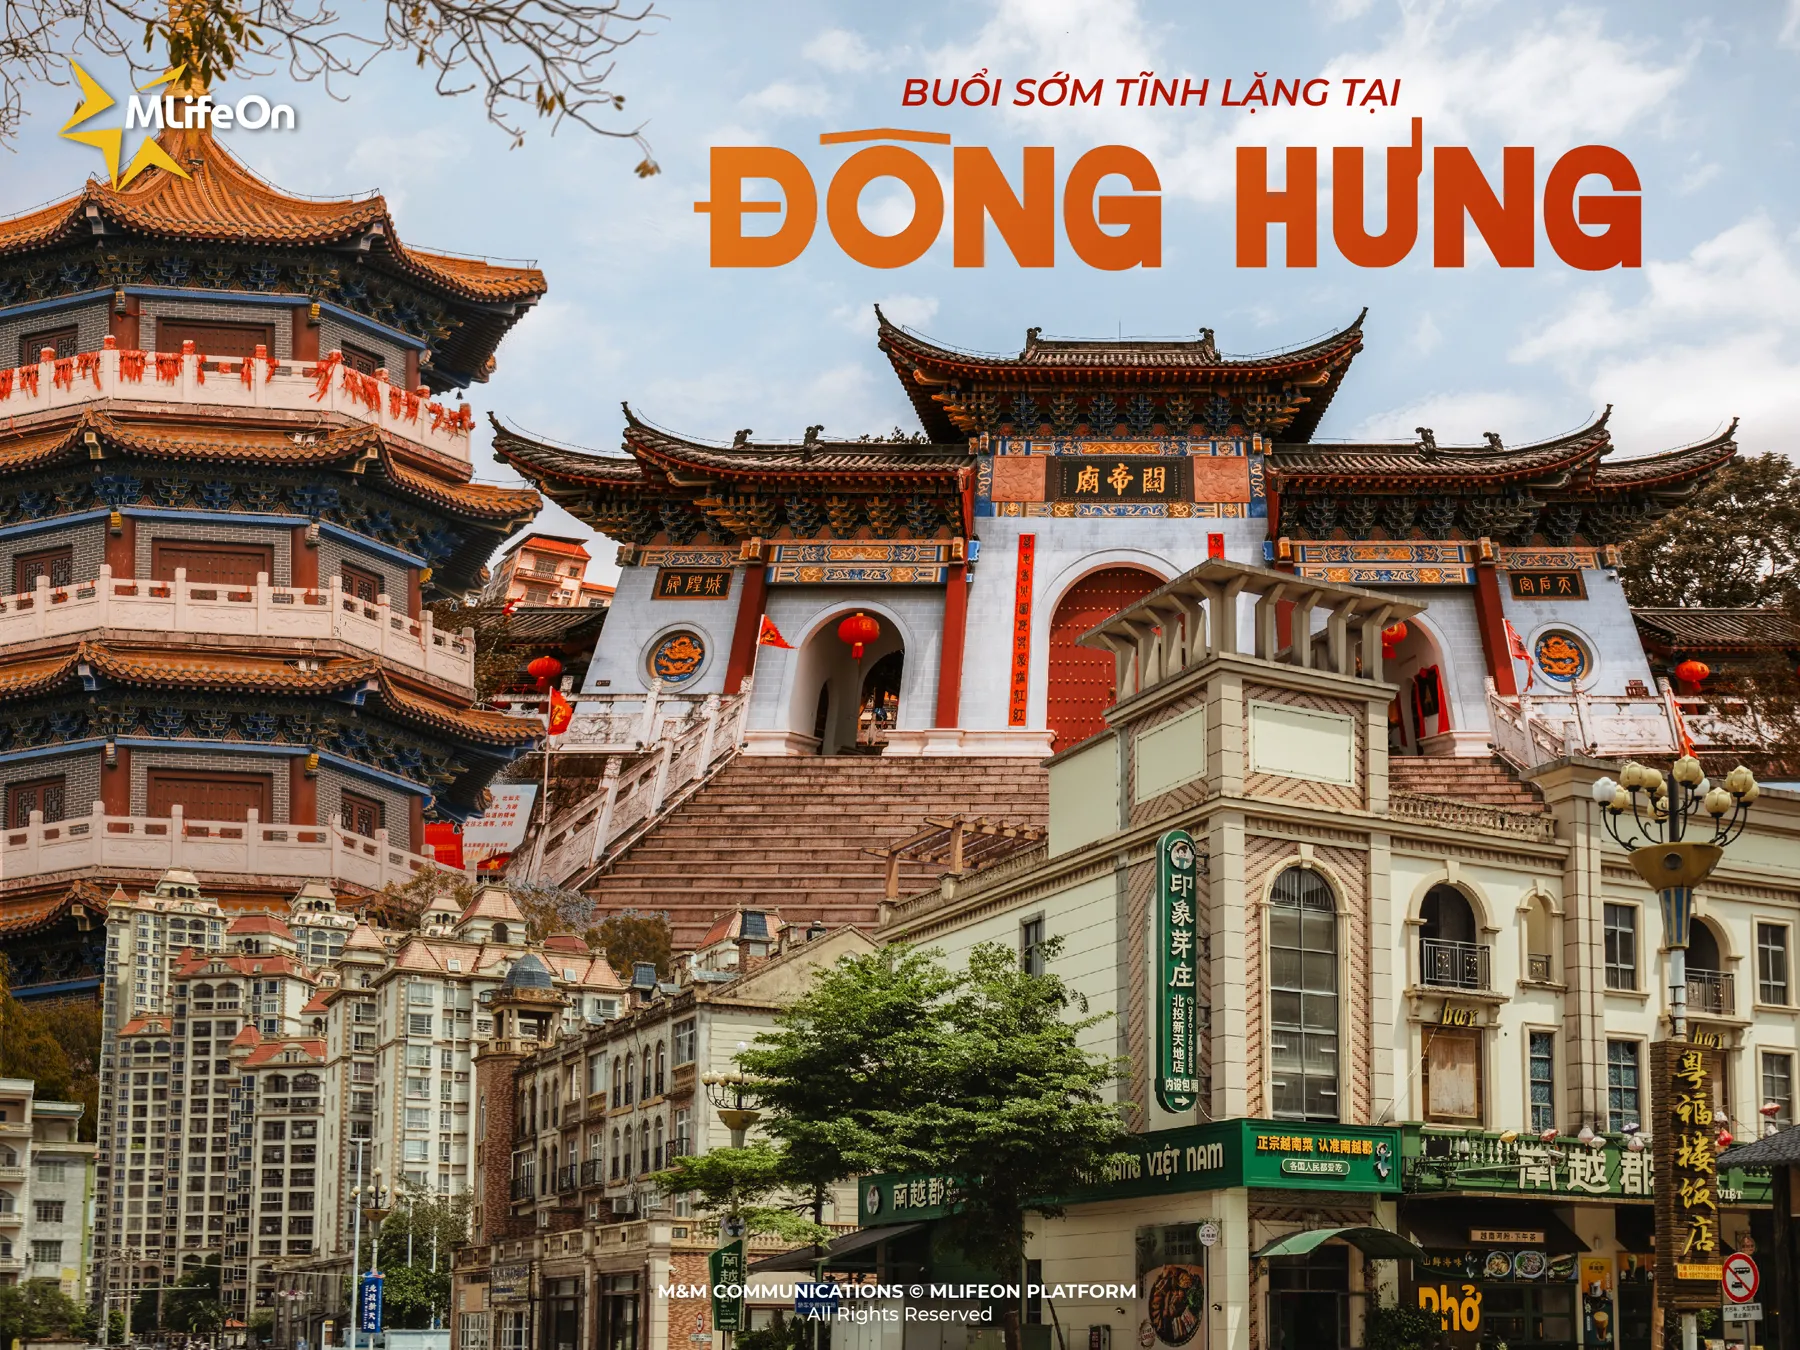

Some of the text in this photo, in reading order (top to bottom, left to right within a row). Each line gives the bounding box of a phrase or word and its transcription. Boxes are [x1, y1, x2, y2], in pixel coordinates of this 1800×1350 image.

[1169, 873, 1195, 987] 印象芽庄
[1172, 994, 1185, 1074] 北投新天地店
[1146, 1143, 1181, 1182] VIỆT
[1257, 1135, 1373, 1155] 正宗越南菜 认准南越郡
[1676, 1049, 1716, 1256] 粤福楼饭店
[1289, 1161, 1343, 1173] 各国人民都爱吃
[893, 1176, 945, 1211] 南越郡
